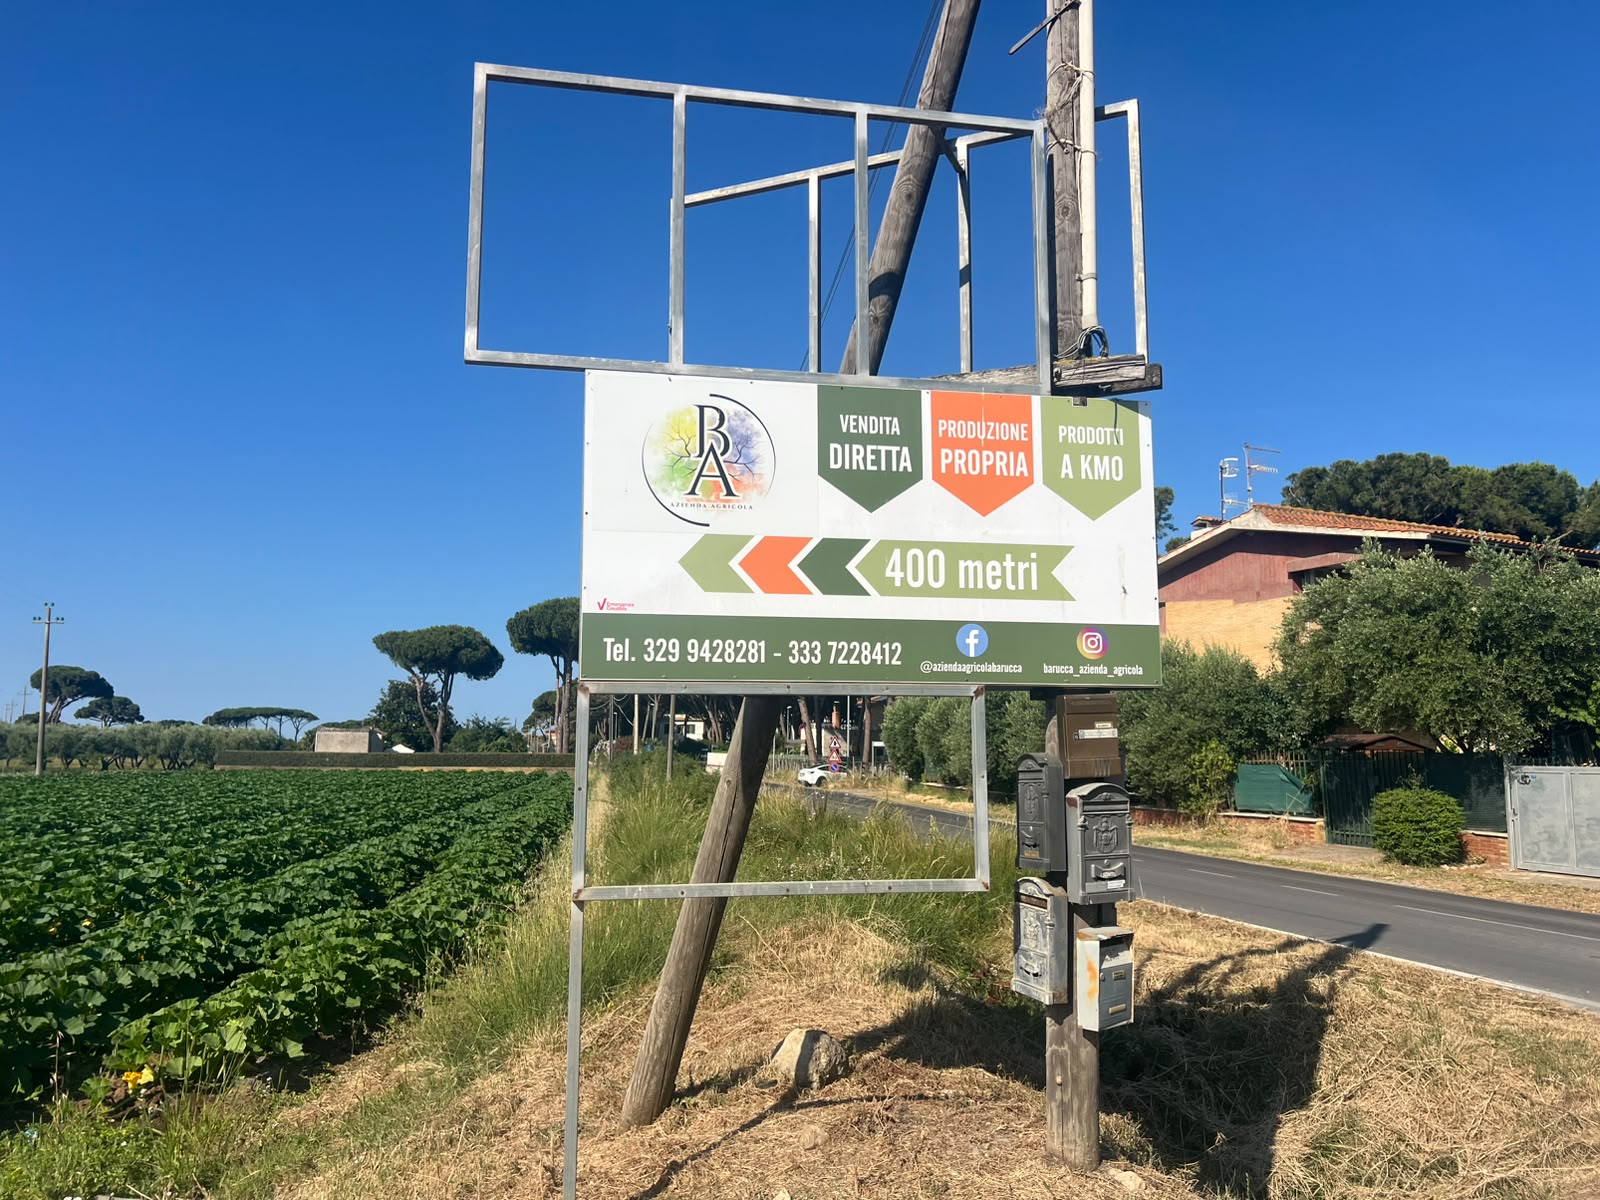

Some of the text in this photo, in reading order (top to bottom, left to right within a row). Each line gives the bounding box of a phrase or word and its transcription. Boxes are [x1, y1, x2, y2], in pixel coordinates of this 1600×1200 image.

[839, 413, 901, 436] VENDITA
[937, 418, 1029, 442] PRODUZIONE
[1058, 425, 1124, 447] PRODOTTI
[829, 442, 913, 473] DIRETTA
[940, 447, 1029, 477] PROPRIA
[1060, 453, 1074, 480] A
[885, 547, 1038, 591] 400 metri
[602, 637, 636, 663] Tel.
[643, 638, 680, 663] 329
[686, 639, 766, 664] 9428281
[788, 641, 822, 665] 333
[827, 641, 902, 666] 7228412
[920, 660, 1023, 675] @aziendaagricolabarucca
[1043, 662, 1144, 677] barucca_azienda_agricola
